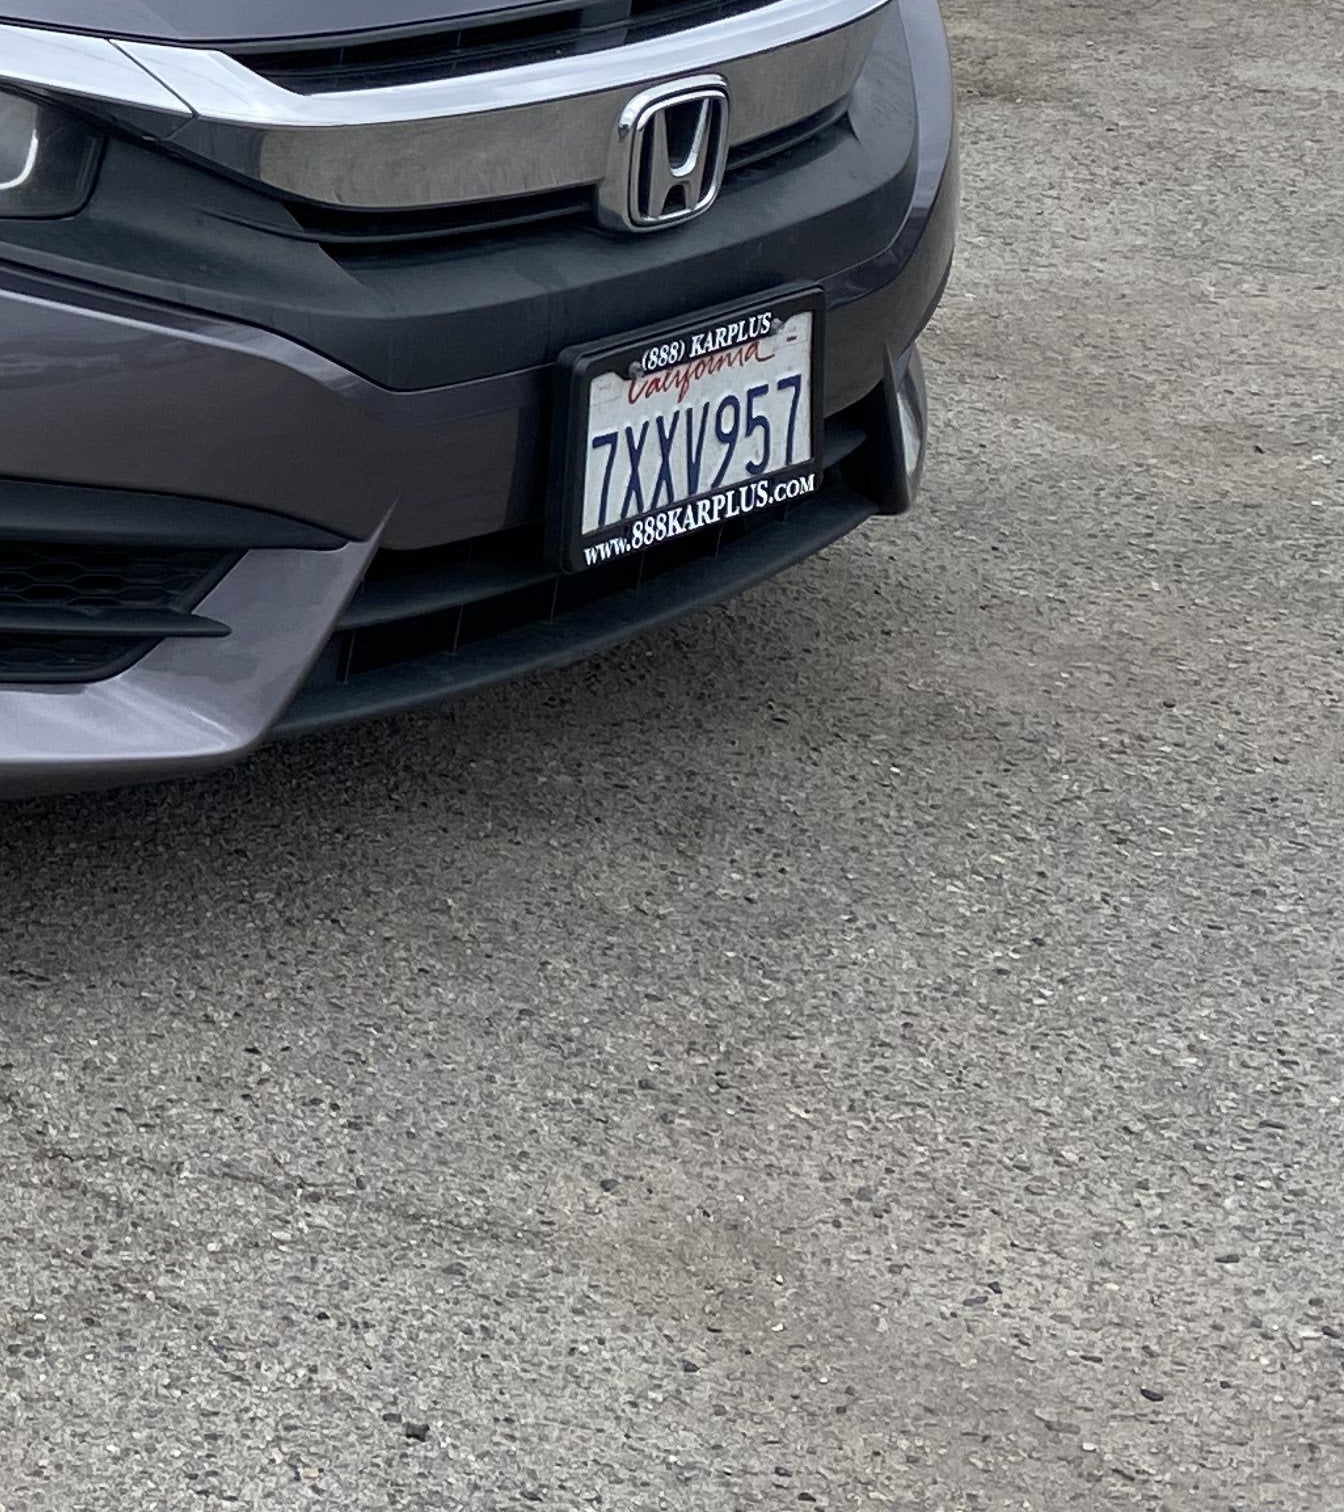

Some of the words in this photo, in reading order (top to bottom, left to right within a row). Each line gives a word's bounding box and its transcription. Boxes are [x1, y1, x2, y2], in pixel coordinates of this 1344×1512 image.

[627, 339, 775, 405] California
[642, 340, 685, 371] (888)
[689, 311, 772, 359] KARPLUS
[591, 374, 802, 529] 7XXV957
